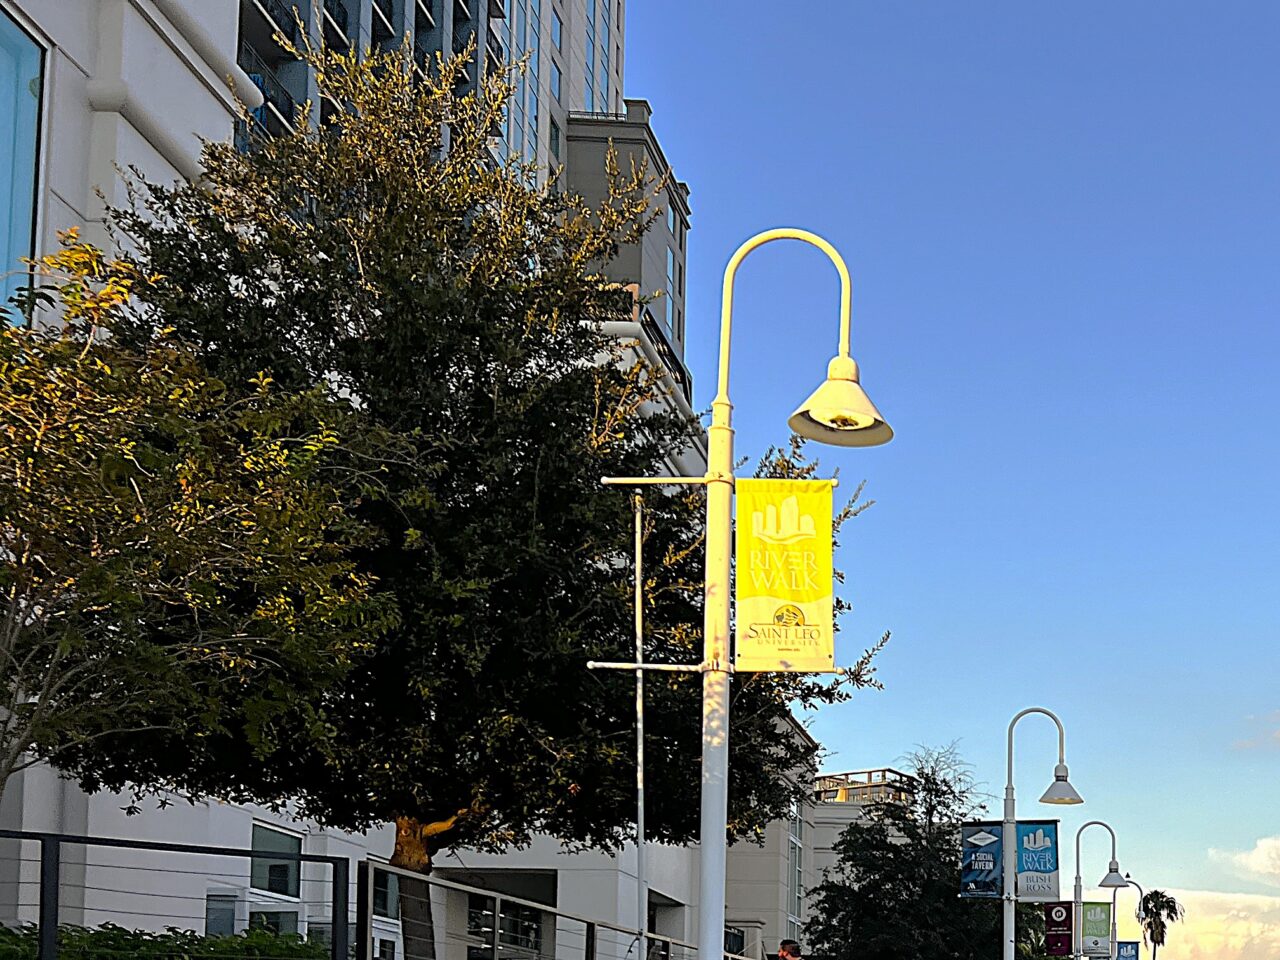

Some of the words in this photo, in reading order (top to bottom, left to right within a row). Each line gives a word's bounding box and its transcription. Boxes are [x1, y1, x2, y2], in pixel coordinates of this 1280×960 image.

[749, 550, 819, 570] RIVER
[749, 570, 820, 591] WALK
[748, 623, 791, 639] SAINT
[795, 628, 821, 639] LEO
[1022, 853, 1052, 862] RIVER
[971, 861, 993, 870] TAVERN
[1023, 861, 1053, 870] WALK
[1026, 884, 1052, 892] ROSS
